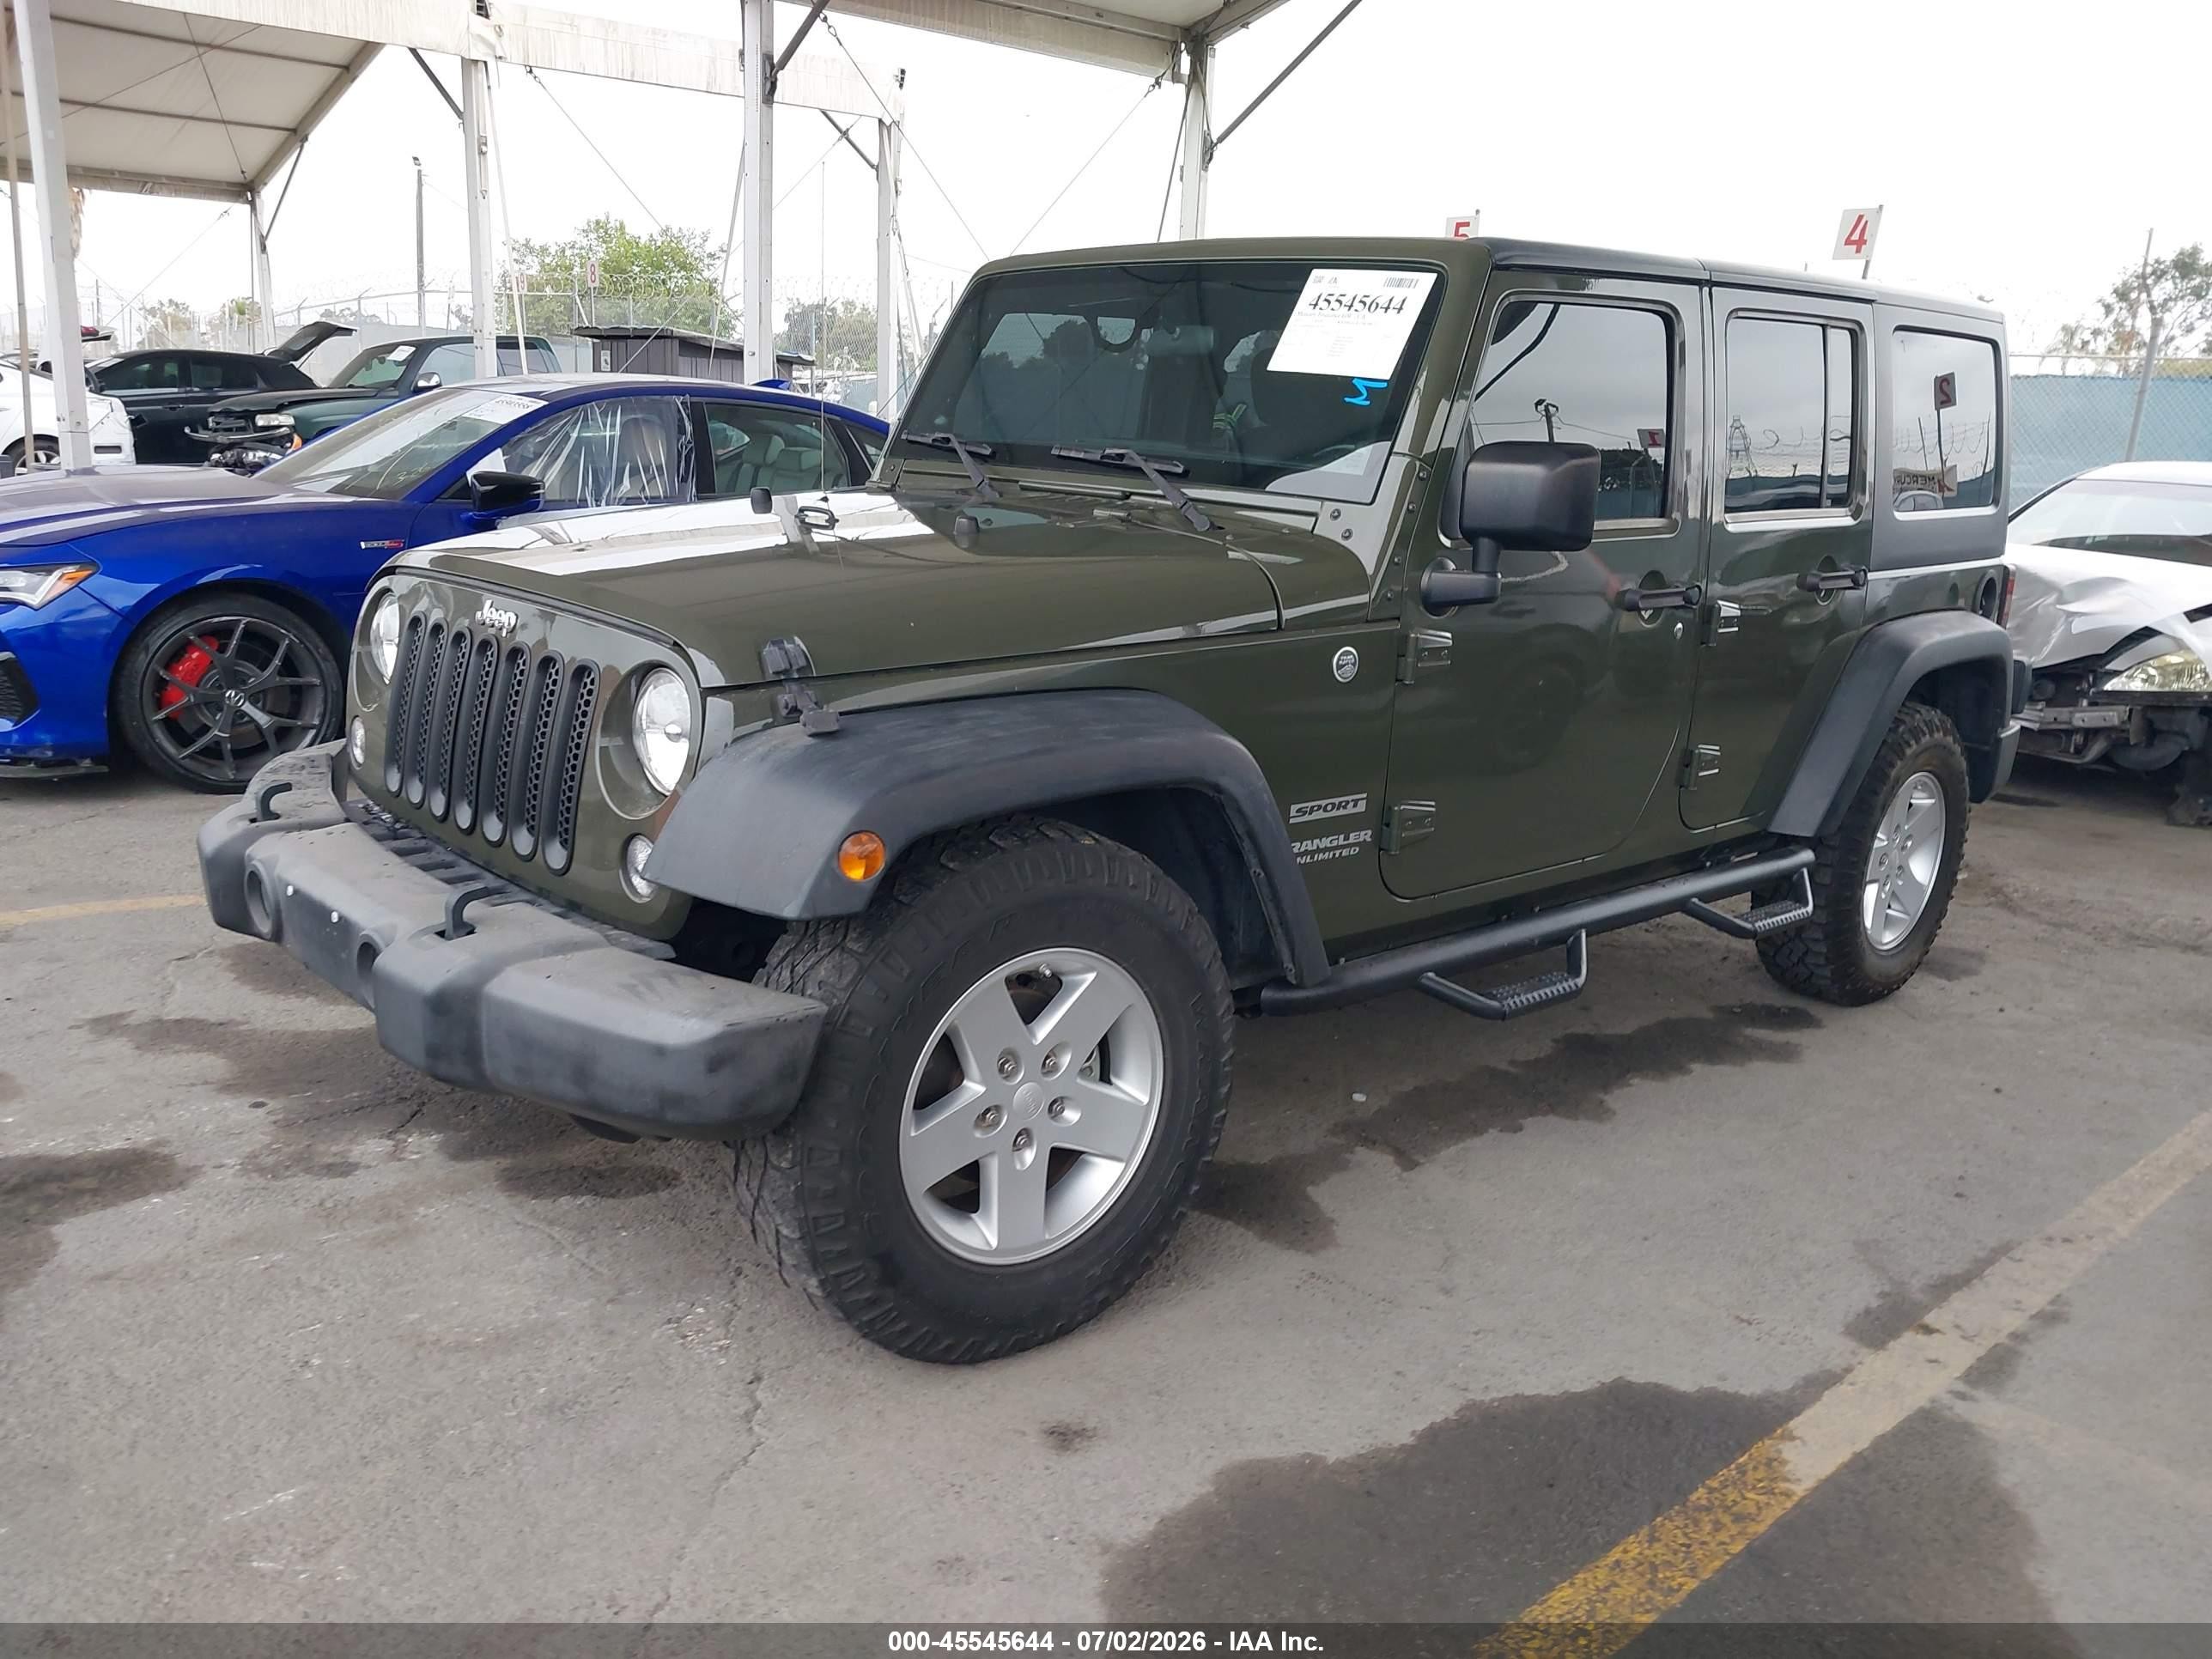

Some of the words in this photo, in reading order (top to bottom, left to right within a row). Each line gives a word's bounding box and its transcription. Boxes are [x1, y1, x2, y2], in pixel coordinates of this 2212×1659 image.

[1844, 214, 1869, 254] 4
[589, 263, 597, 284] 8
[1308, 291, 1408, 314] 45545644
[475, 599, 519, 638] Jeep
[1291, 798, 1366, 817] SPORT
[1291, 830, 1373, 854] RANGLER
[1296, 847, 1360, 866] NLIMITED
